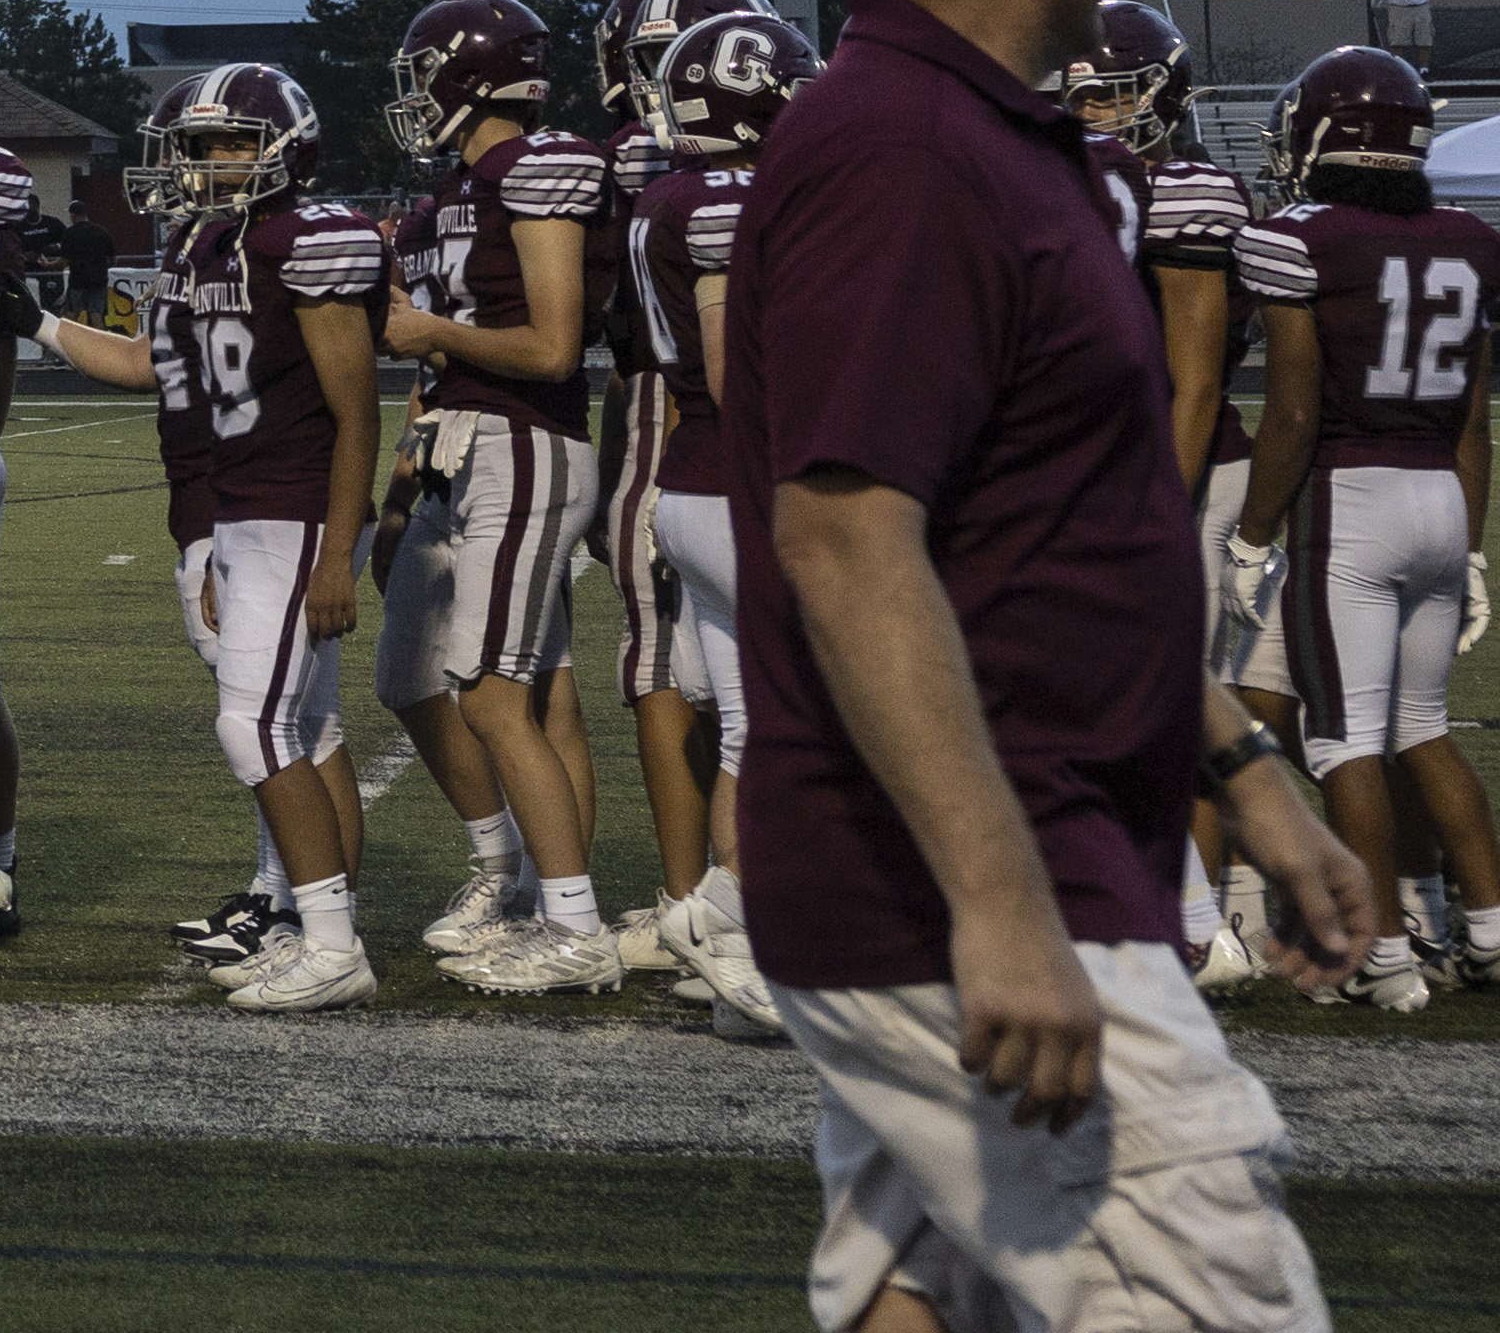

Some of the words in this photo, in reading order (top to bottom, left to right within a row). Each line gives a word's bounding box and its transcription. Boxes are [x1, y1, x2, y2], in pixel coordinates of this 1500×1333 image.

[640, 21, 671, 33] Riddell
[709, 25, 777, 97] G
[1364, 255, 1481, 402] 12
